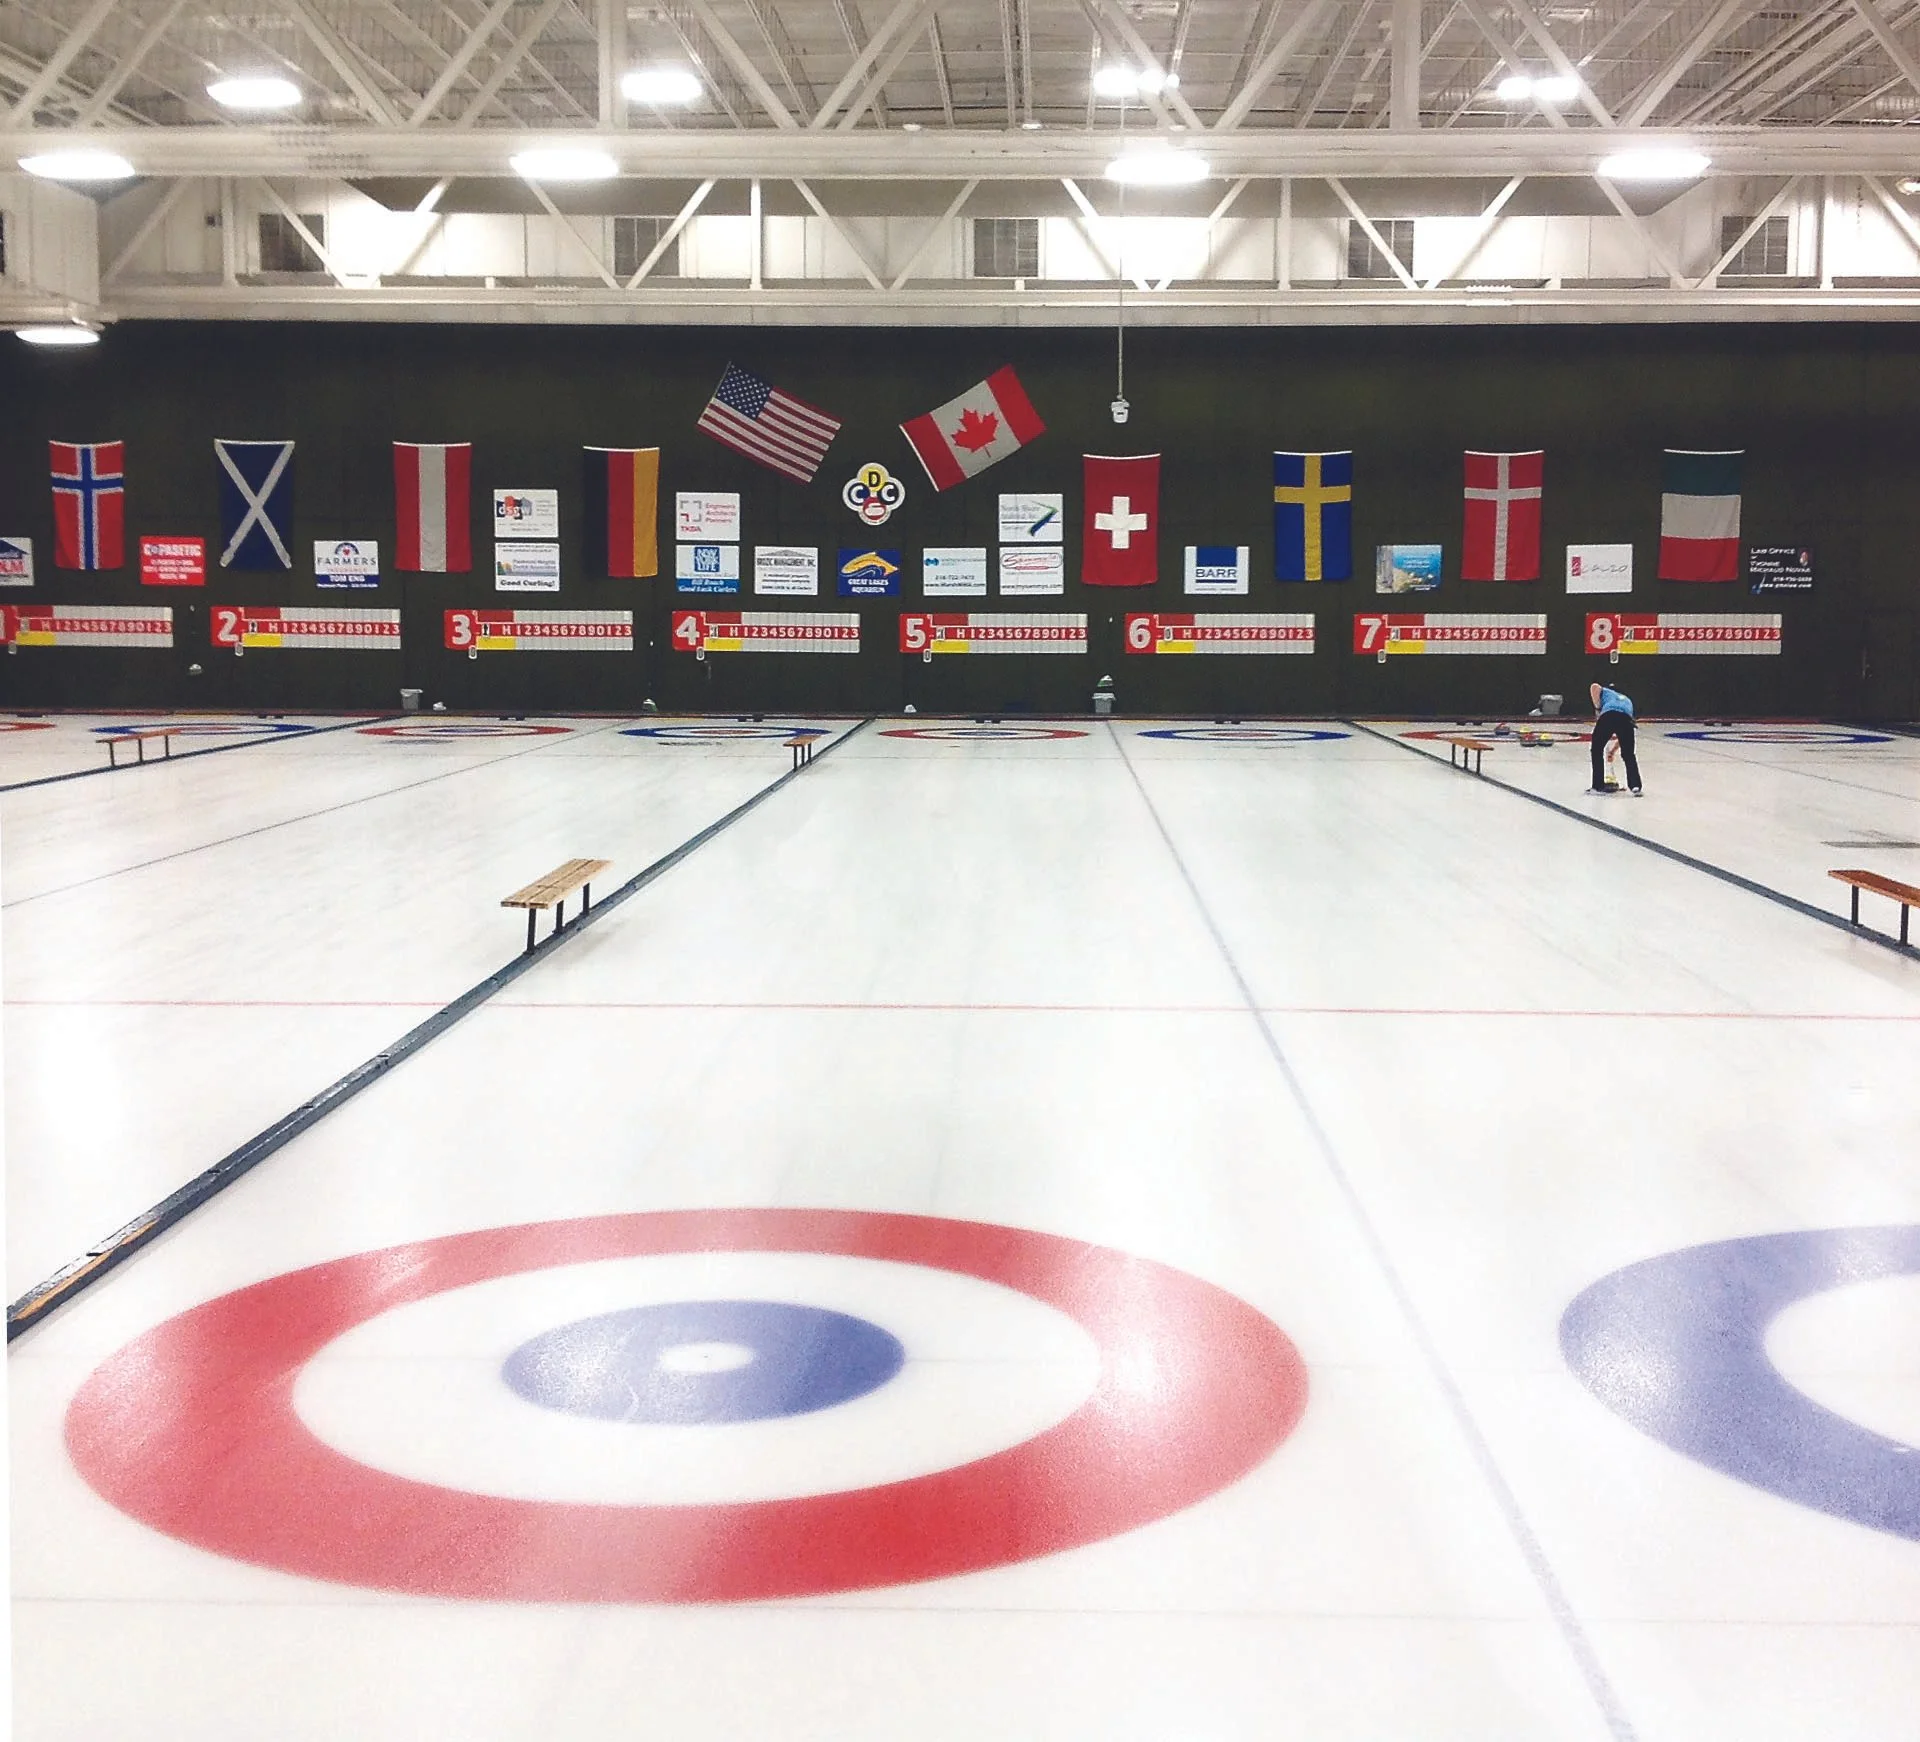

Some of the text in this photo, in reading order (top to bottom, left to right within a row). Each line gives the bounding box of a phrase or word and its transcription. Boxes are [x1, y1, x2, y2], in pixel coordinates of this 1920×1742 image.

[869, 471, 881, 487] D
[882, 484, 895, 501] C
[850, 485, 864, 504] C
[317, 557, 377, 566] FARMERS
[1196, 568, 1238, 578] BARR
[218, 611, 238, 641] 2
[452, 614, 471, 646] 3
[676, 617, 700, 647] 4
[906, 618, 925, 649] 5
[1129, 618, 1151, 649] 6
[1360, 618, 1380, 649] 7
[1591, 618, 1613, 650] 8
